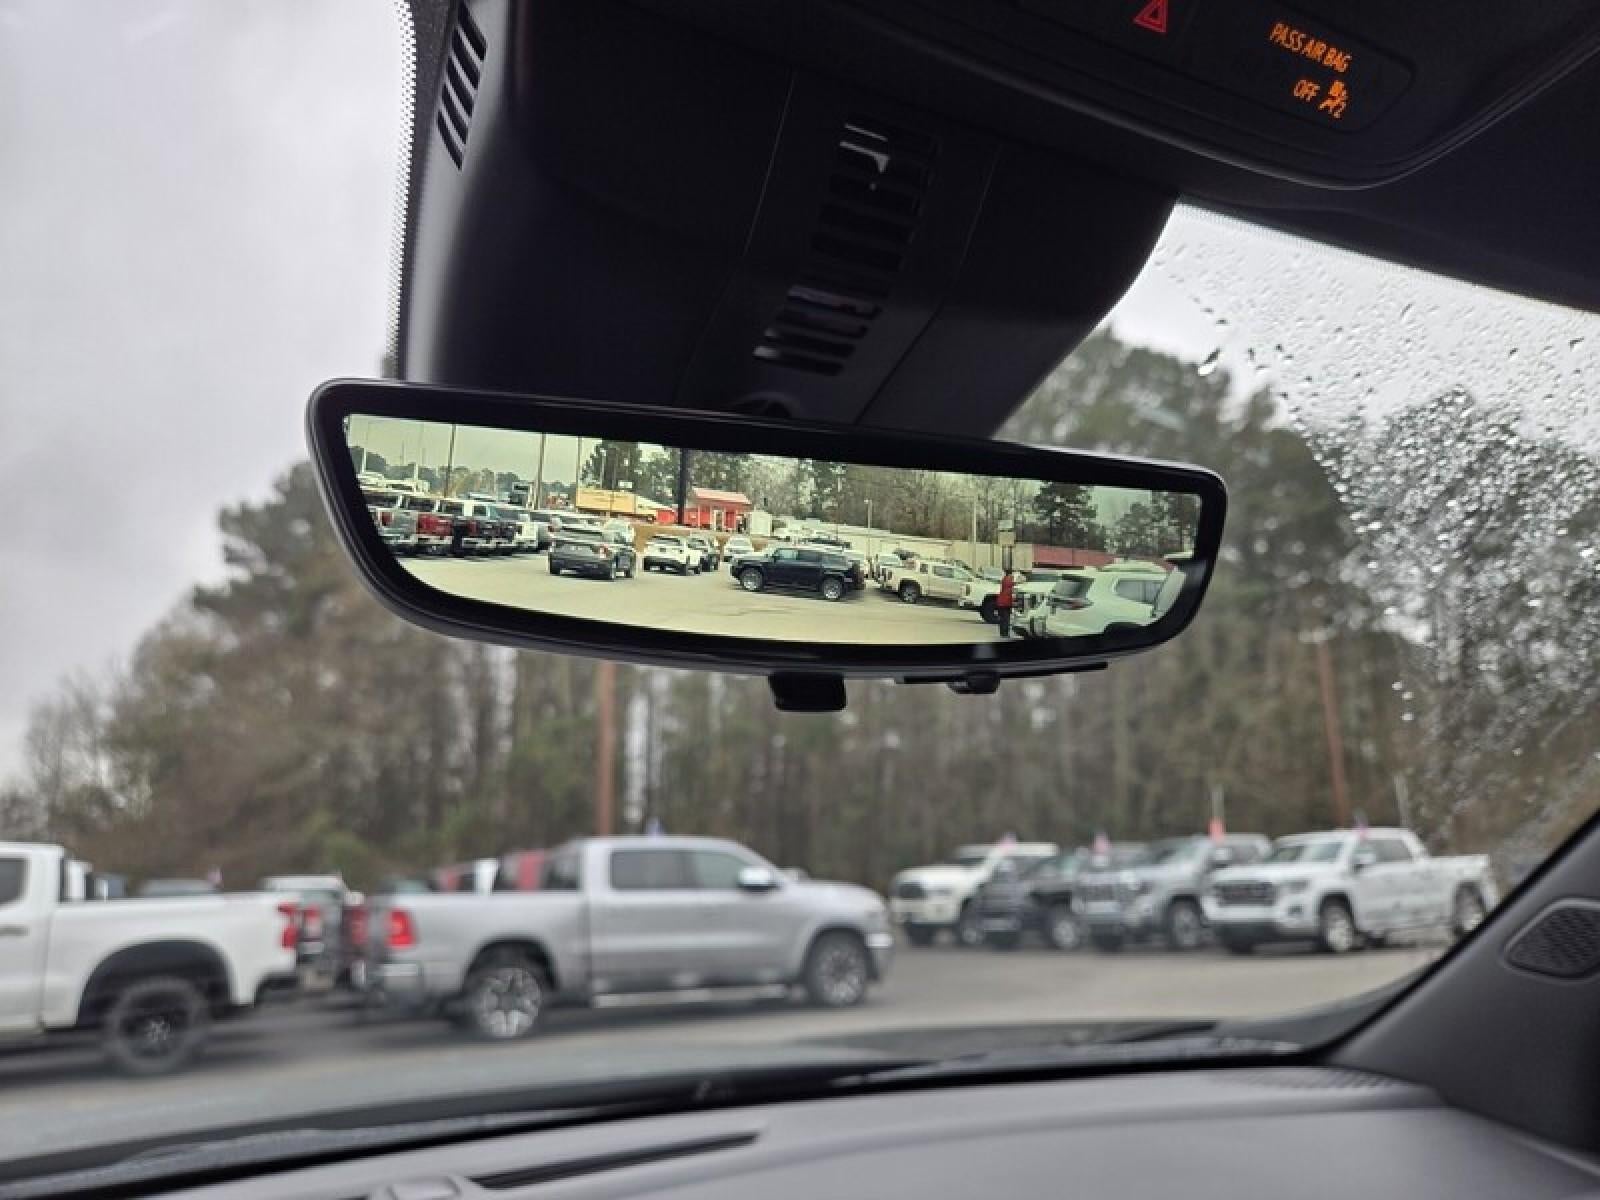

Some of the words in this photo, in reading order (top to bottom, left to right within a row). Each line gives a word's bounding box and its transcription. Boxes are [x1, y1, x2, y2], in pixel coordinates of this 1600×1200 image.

[1269, 23, 1307, 52] PASS
[1302, 39, 1327, 62] AIR
[1323, 47, 1352, 72] BAG
[1294, 80, 1320, 101] OFF
